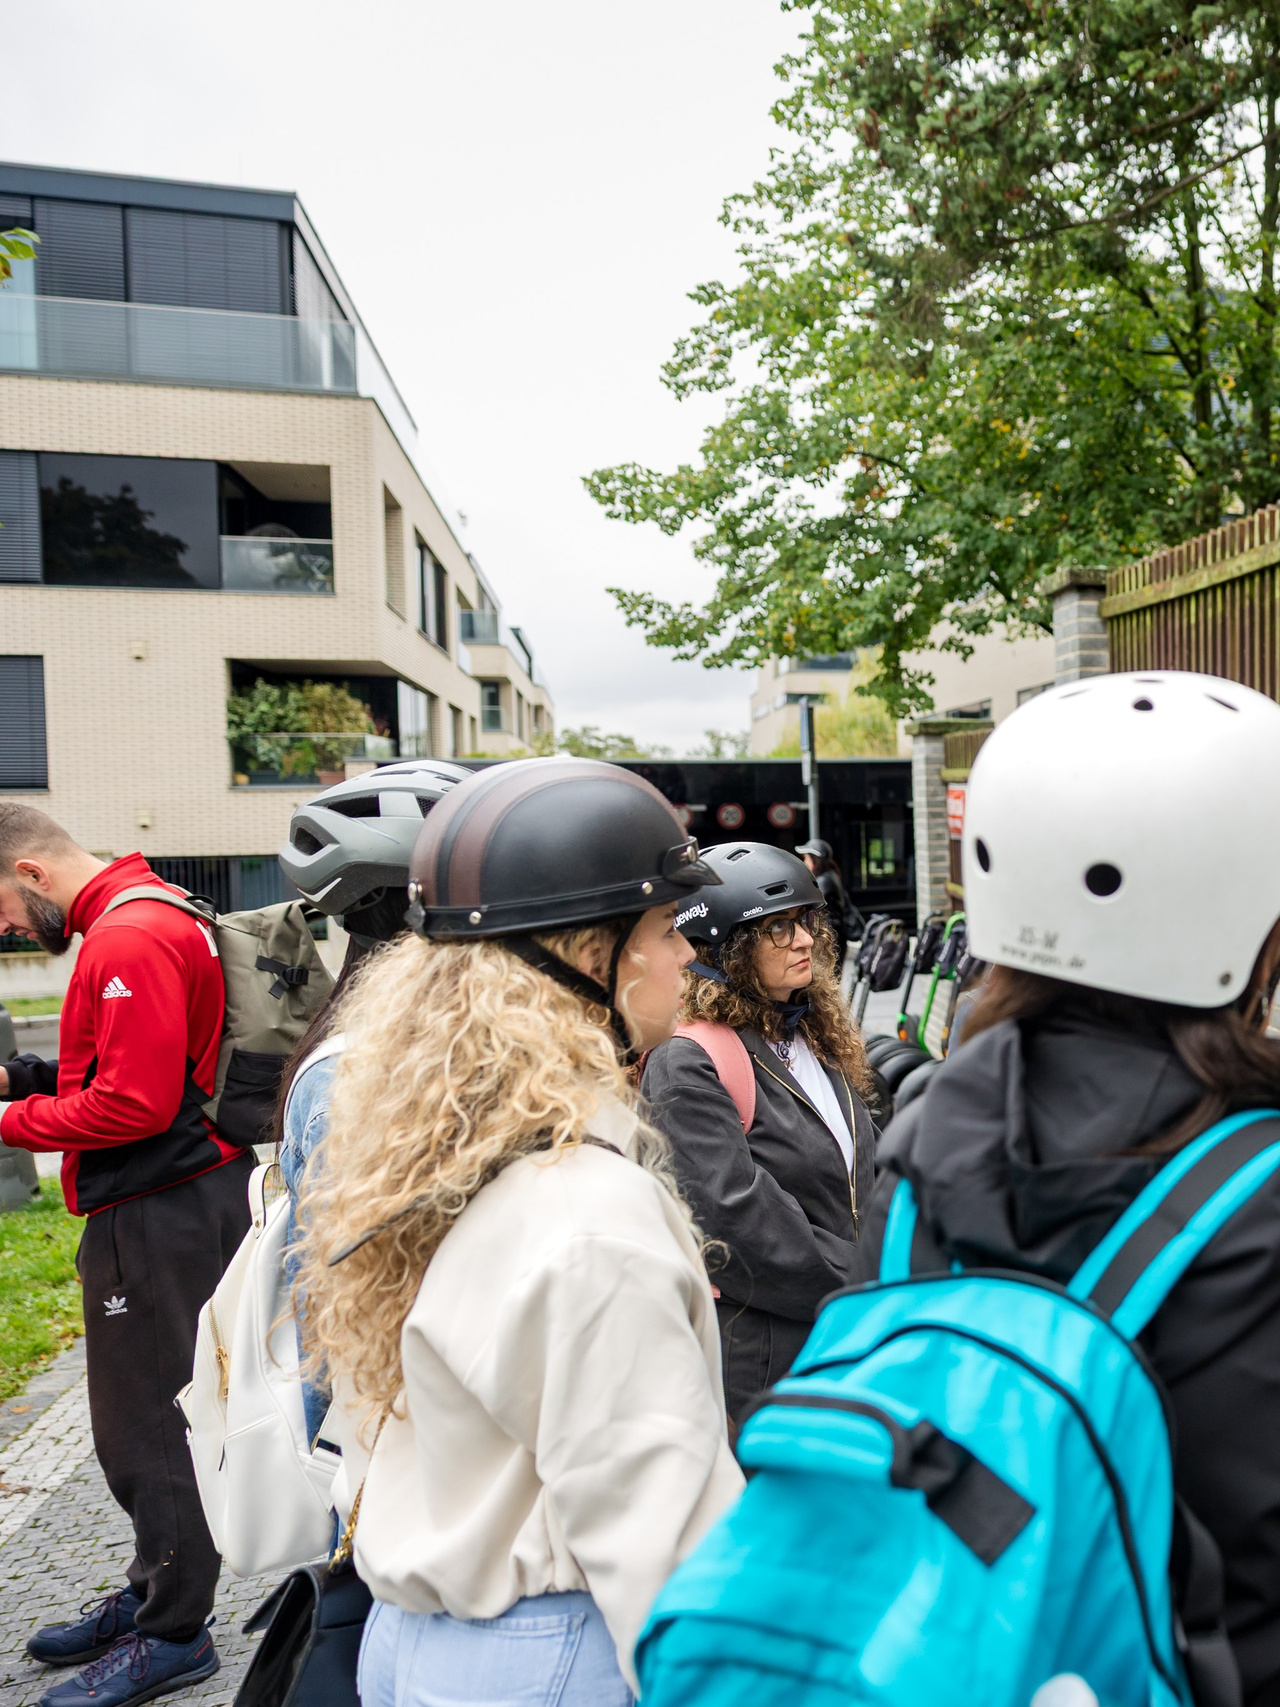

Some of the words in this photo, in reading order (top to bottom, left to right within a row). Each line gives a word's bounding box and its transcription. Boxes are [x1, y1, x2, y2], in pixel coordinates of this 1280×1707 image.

[674, 903, 709, 930] ueway.
[102, 989, 132, 999] adidas
[105, 1307, 127, 1316] adidas
